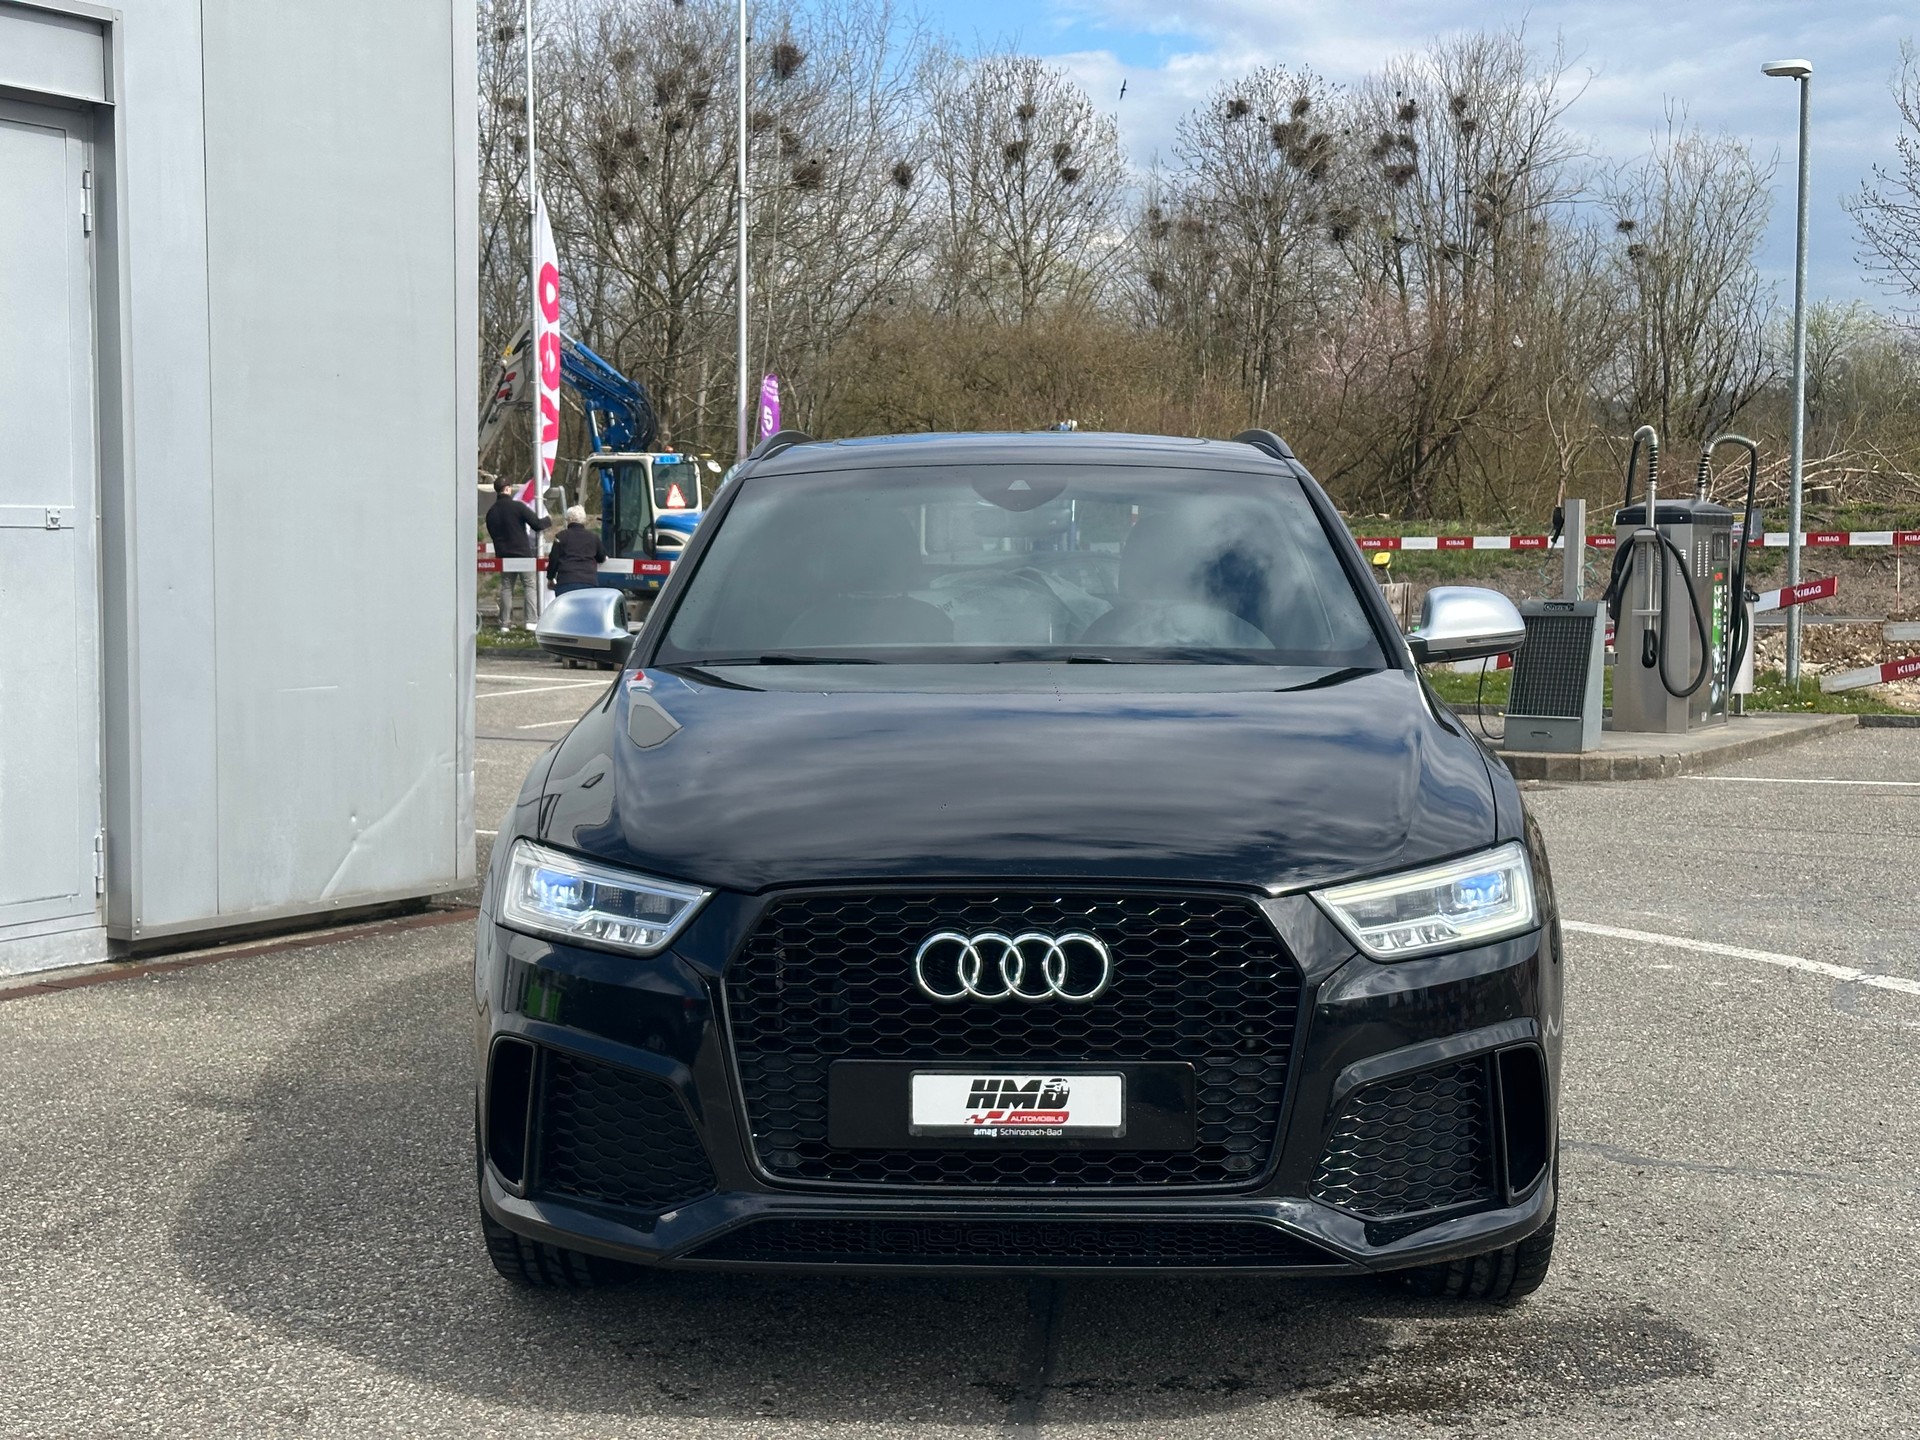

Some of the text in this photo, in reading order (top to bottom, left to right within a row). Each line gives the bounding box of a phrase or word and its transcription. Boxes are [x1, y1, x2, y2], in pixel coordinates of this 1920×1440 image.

[1793, 585, 1821, 598] KIBAG
[1897, 662, 1920, 675] KIBA
[966, 1078, 1071, 1110] HMD
[973, 1128, 1063, 1137] amag Schinznach-Bad
[881, 1224, 1143, 1252] quattro
